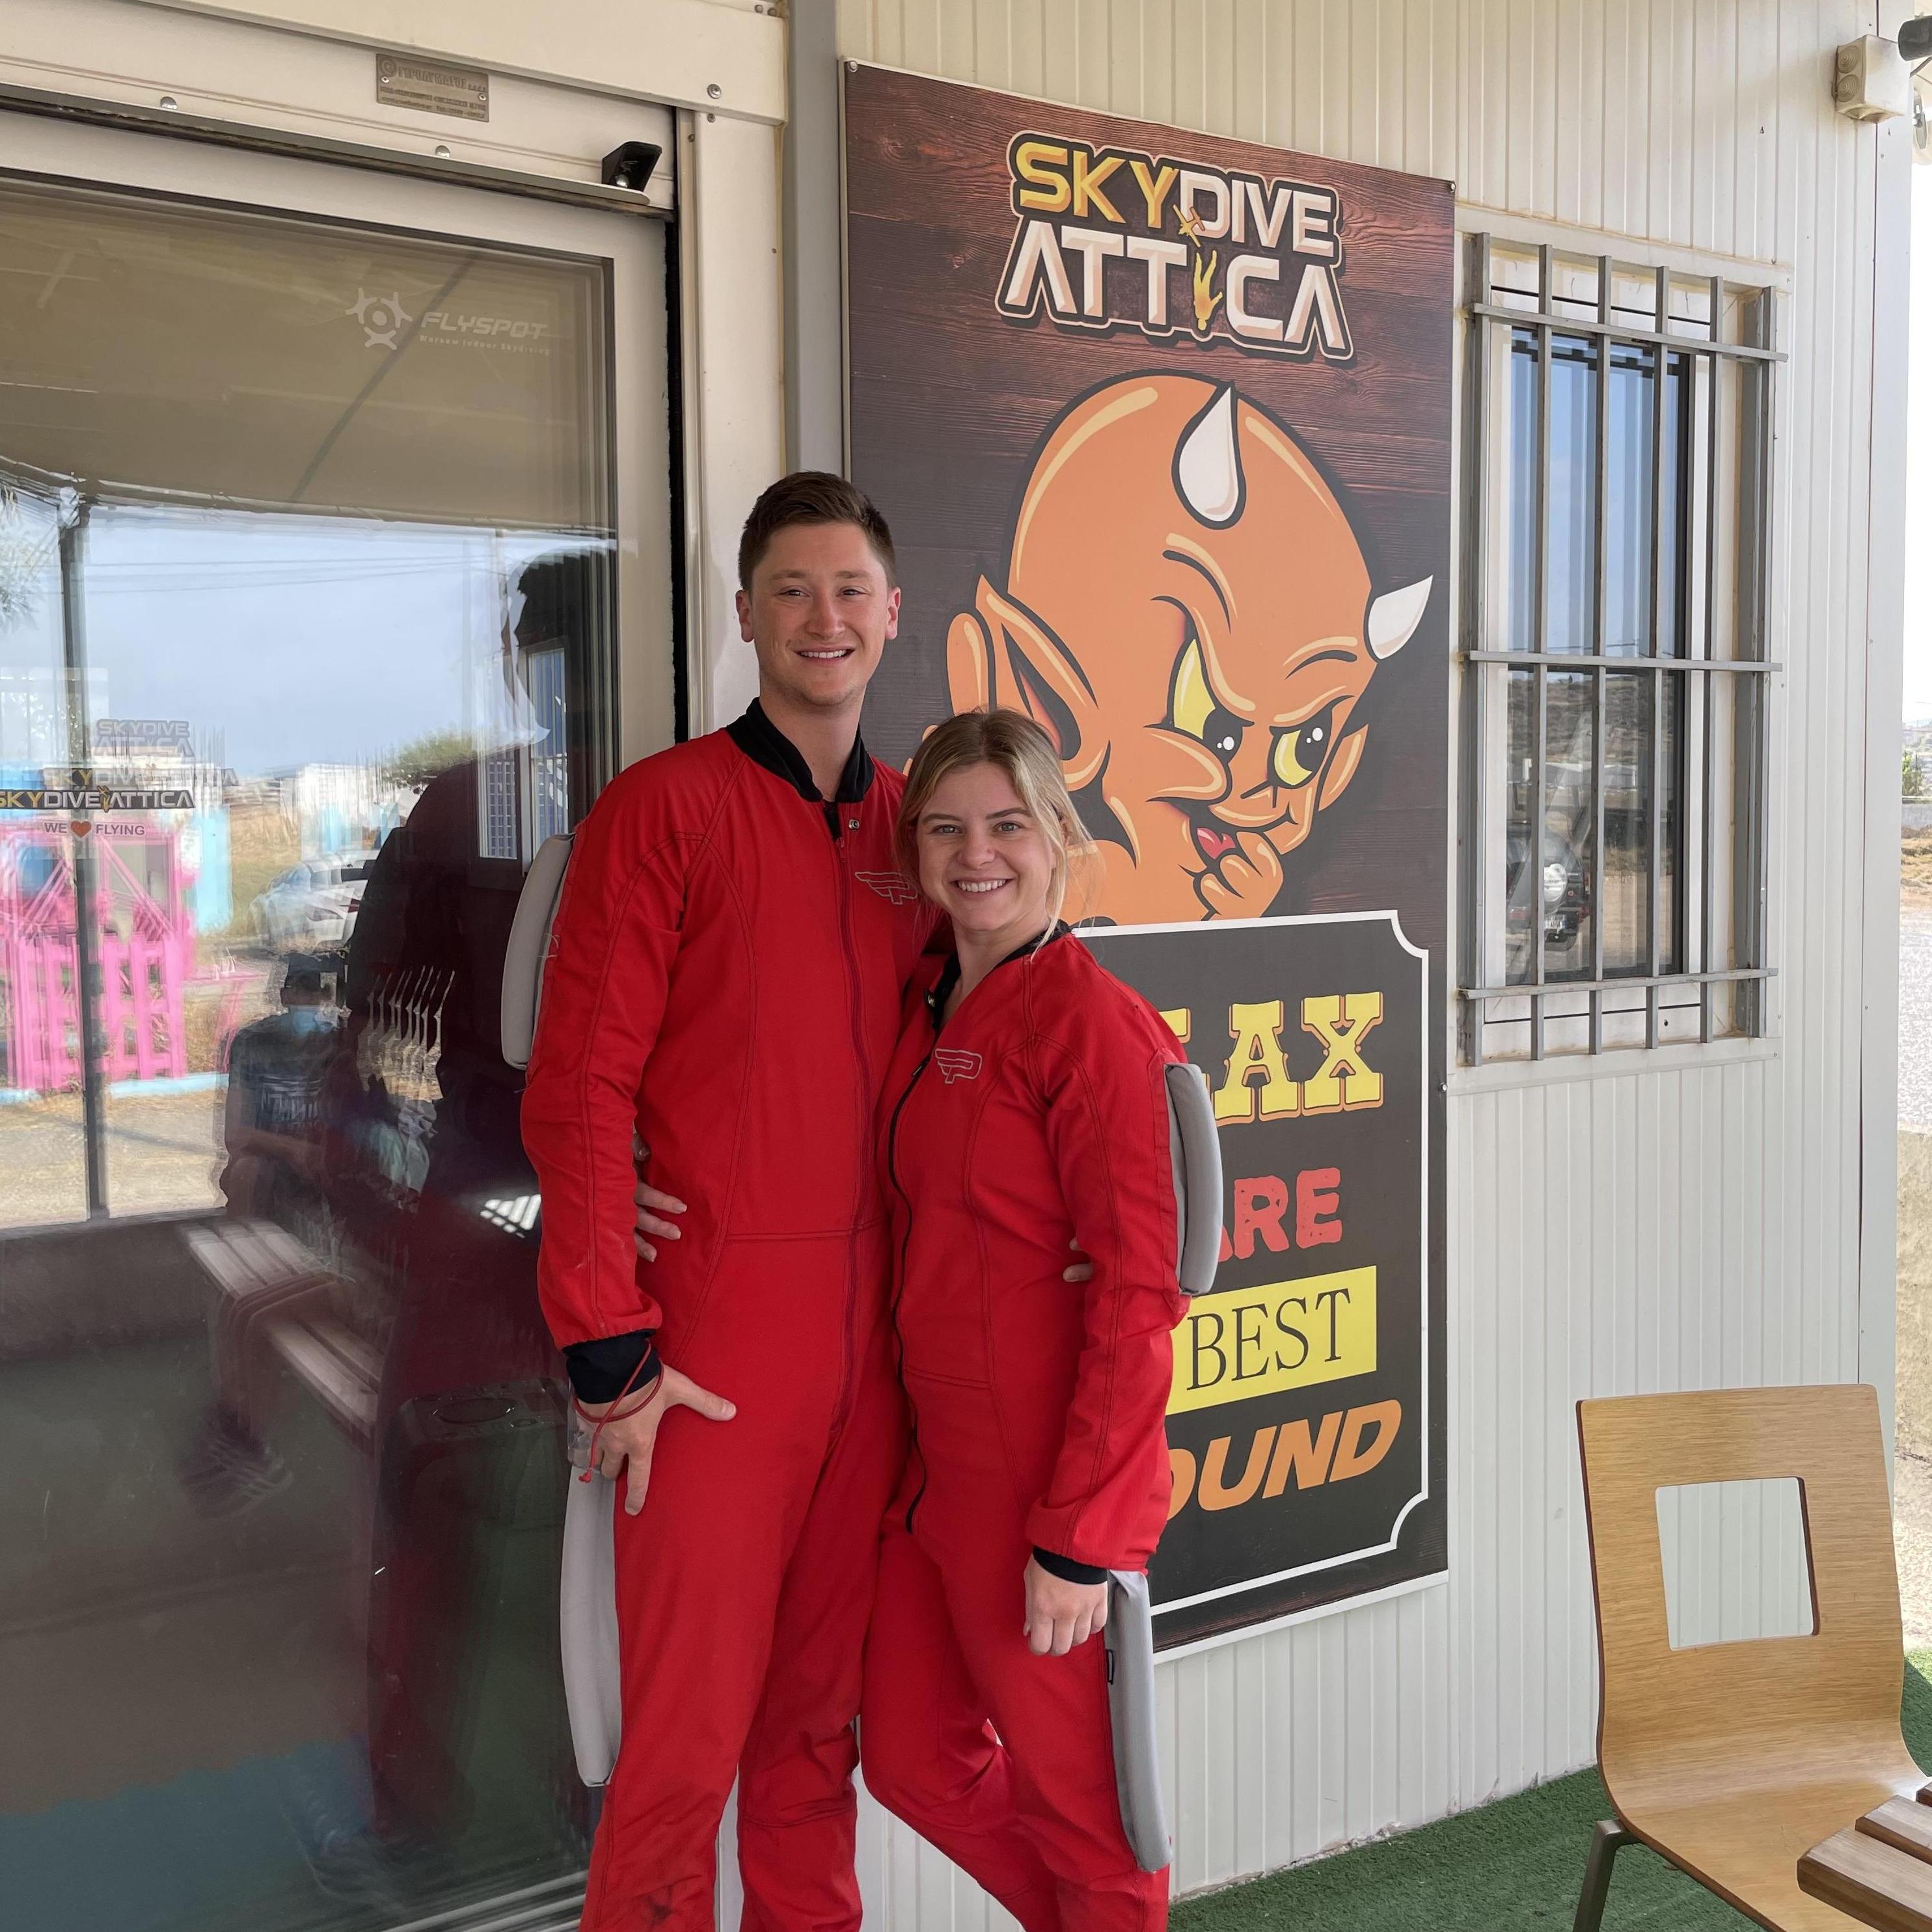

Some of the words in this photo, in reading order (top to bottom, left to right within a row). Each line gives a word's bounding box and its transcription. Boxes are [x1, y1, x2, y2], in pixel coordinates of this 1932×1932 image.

[1016, 141, 1335, 258] SKYDIVE
[1004, 219, 1346, 349] ATTICA
[420, 311, 549, 340] FLYSPOT
[501, 342, 550, 357] Skydiving
[98, 720, 186, 736] SKYDIVE
[44, 822, 68, 834] WE
[96, 823, 145, 836] FLYING
[109, 791, 193, 808] ATTICA
[1159, 991, 1383, 1127] AX
[1218, 1167, 1342, 1262] RE
[1186, 1288, 1351, 1391] BEST
